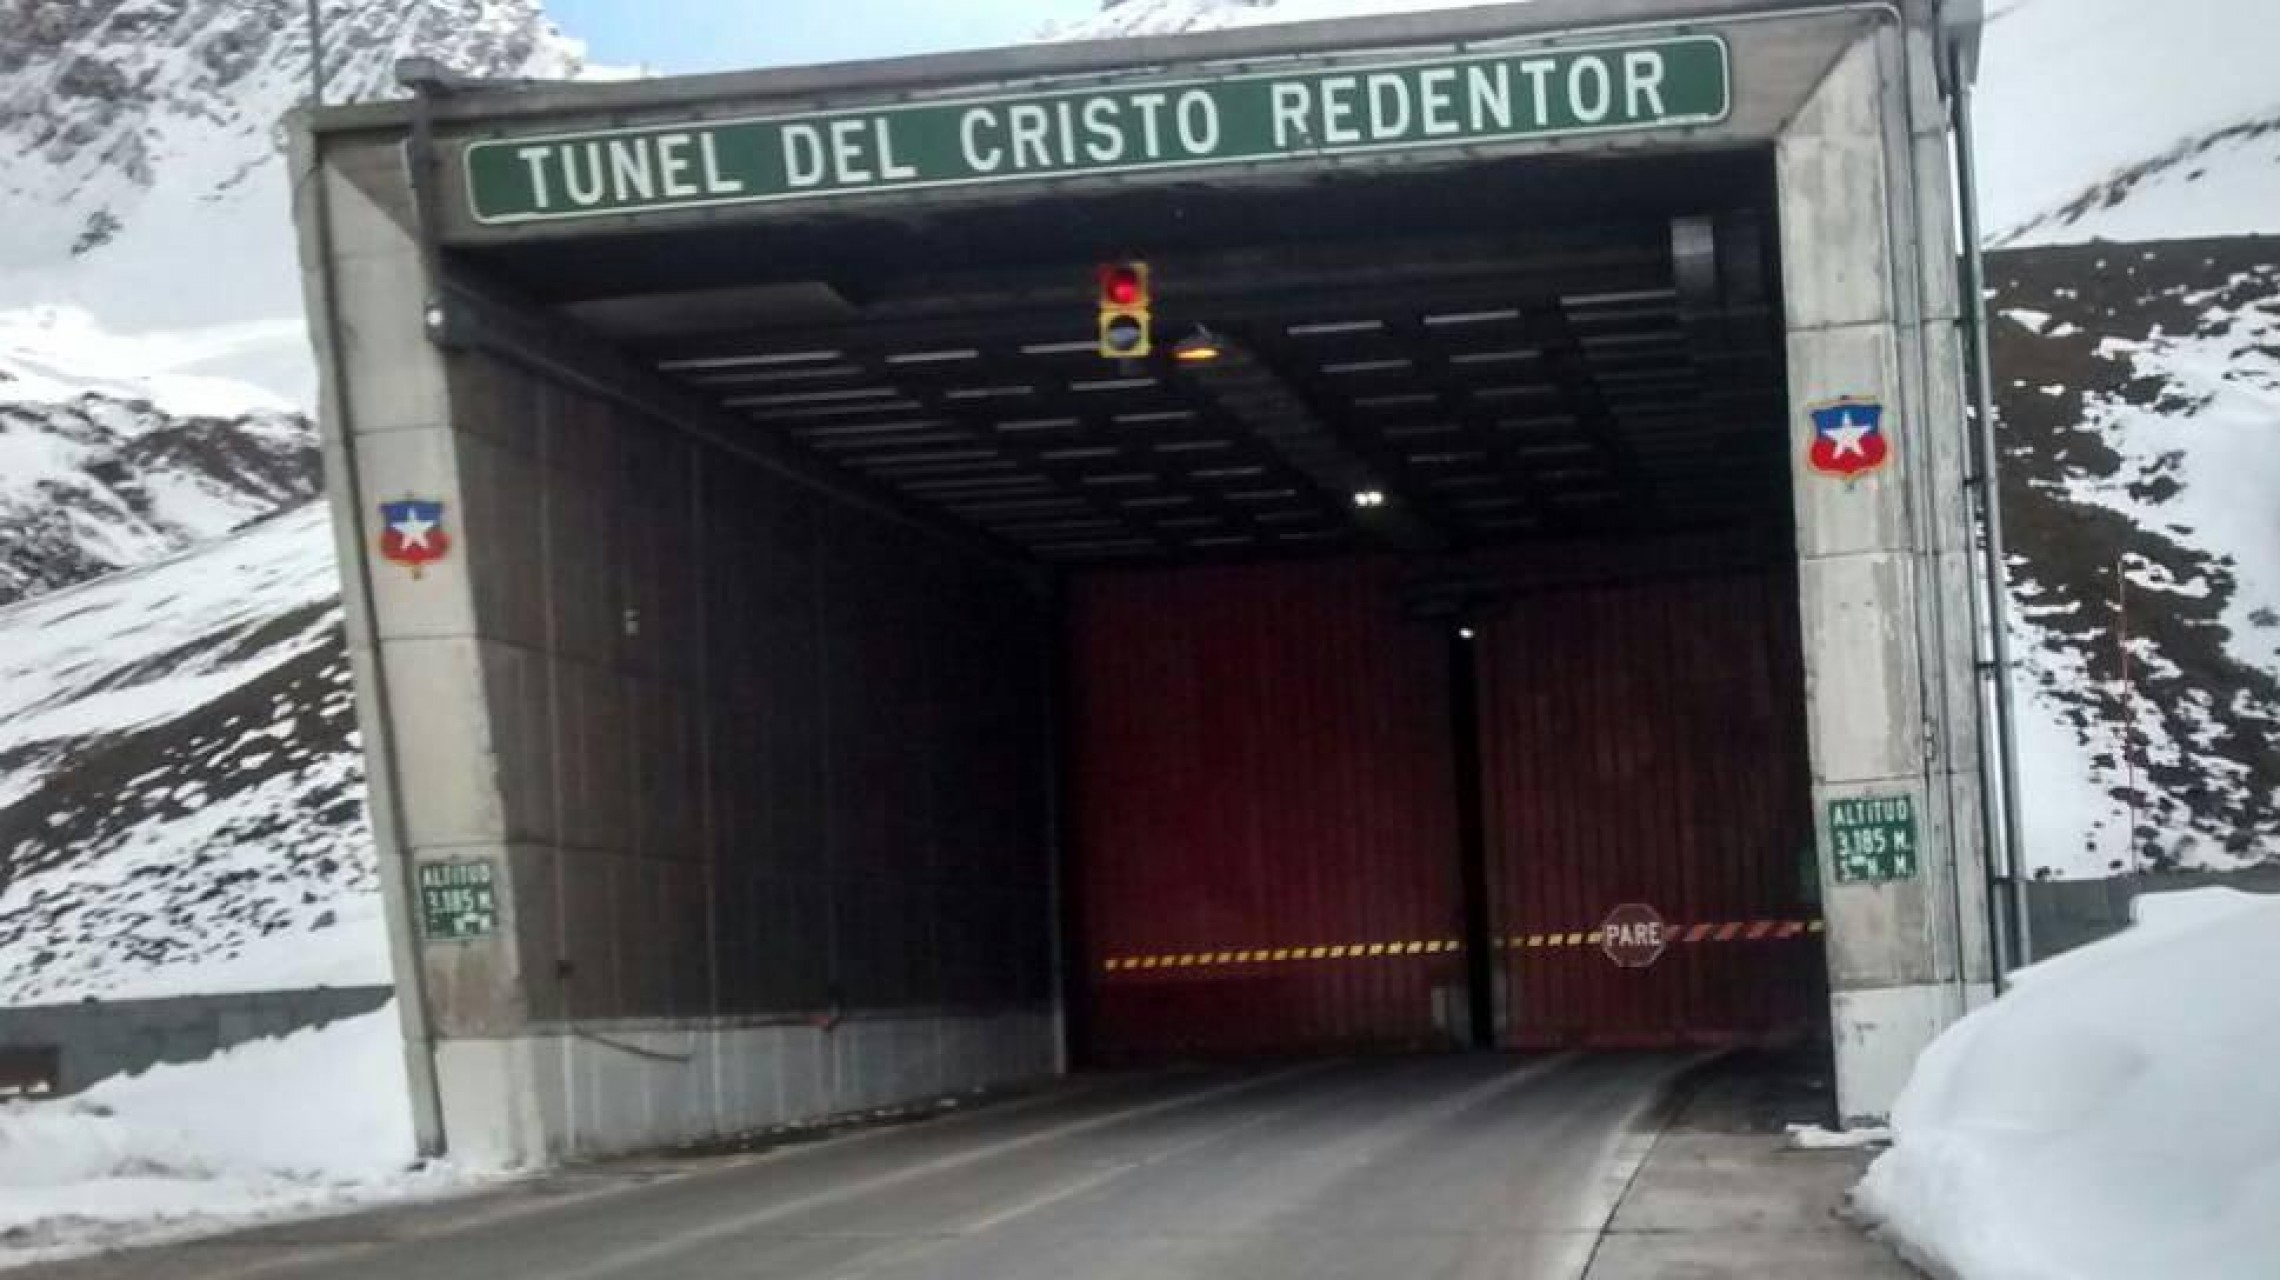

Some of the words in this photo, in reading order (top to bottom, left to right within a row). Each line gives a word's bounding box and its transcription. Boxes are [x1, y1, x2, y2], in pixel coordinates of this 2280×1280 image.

[518, 131, 743, 208] TUNEL
[780, 117, 917, 188] DEL
[959, 90, 1220, 172] CRISTO
[1271, 51, 1666, 147] REDENTOR
[1832, 800, 1908, 826] ALTITUD
[423, 863, 490, 887] ALTITUD
[1606, 921, 1662, 947] PARE
